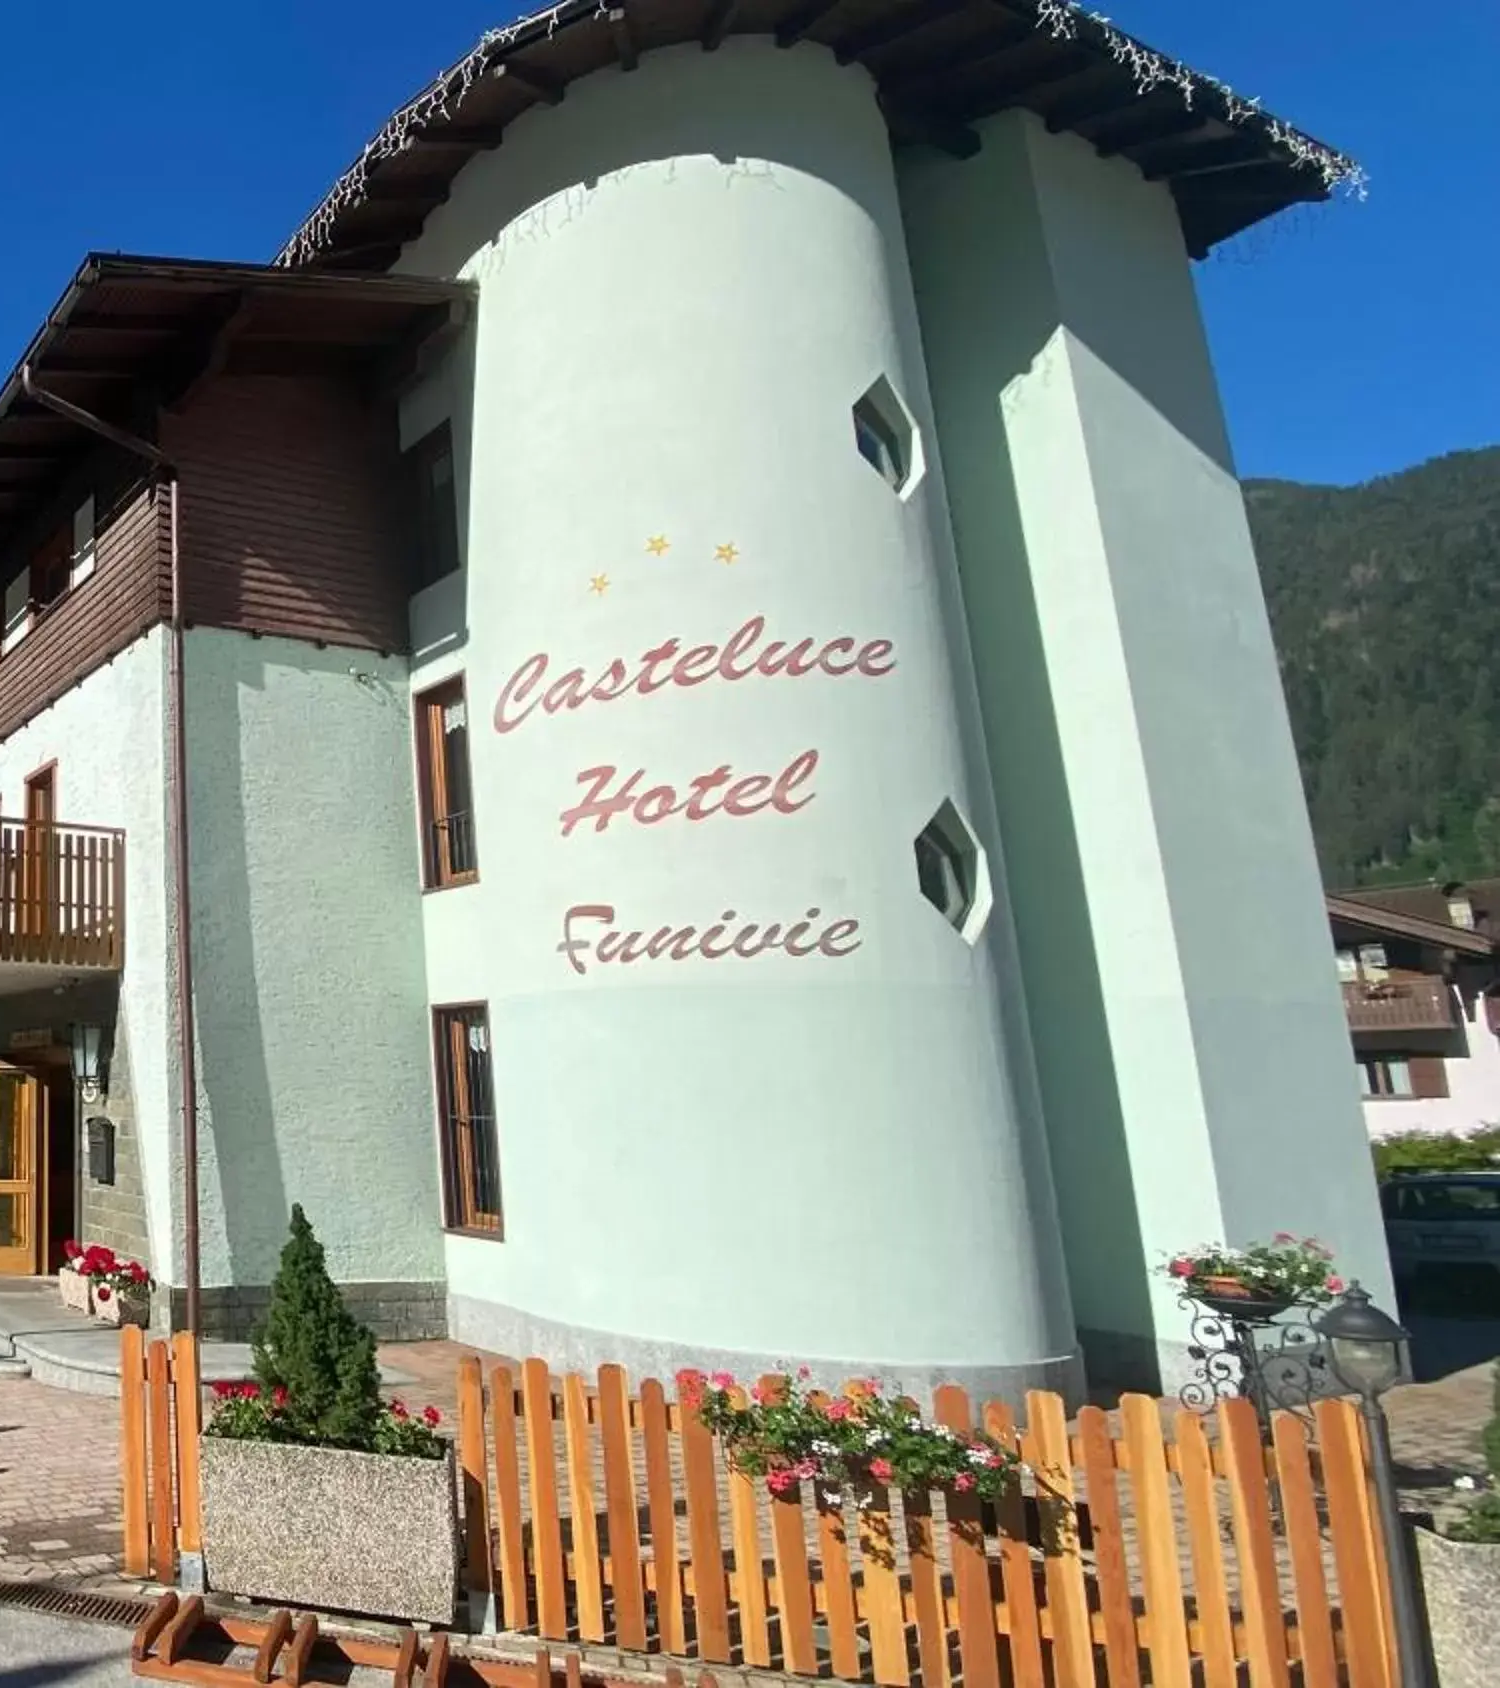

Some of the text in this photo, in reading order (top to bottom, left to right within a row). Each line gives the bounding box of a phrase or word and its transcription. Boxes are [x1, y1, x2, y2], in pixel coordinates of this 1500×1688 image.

[492, 614, 898, 735] Casteluce
[559, 748, 819, 838] Hotel
[555, 904, 864, 975] Funivie
